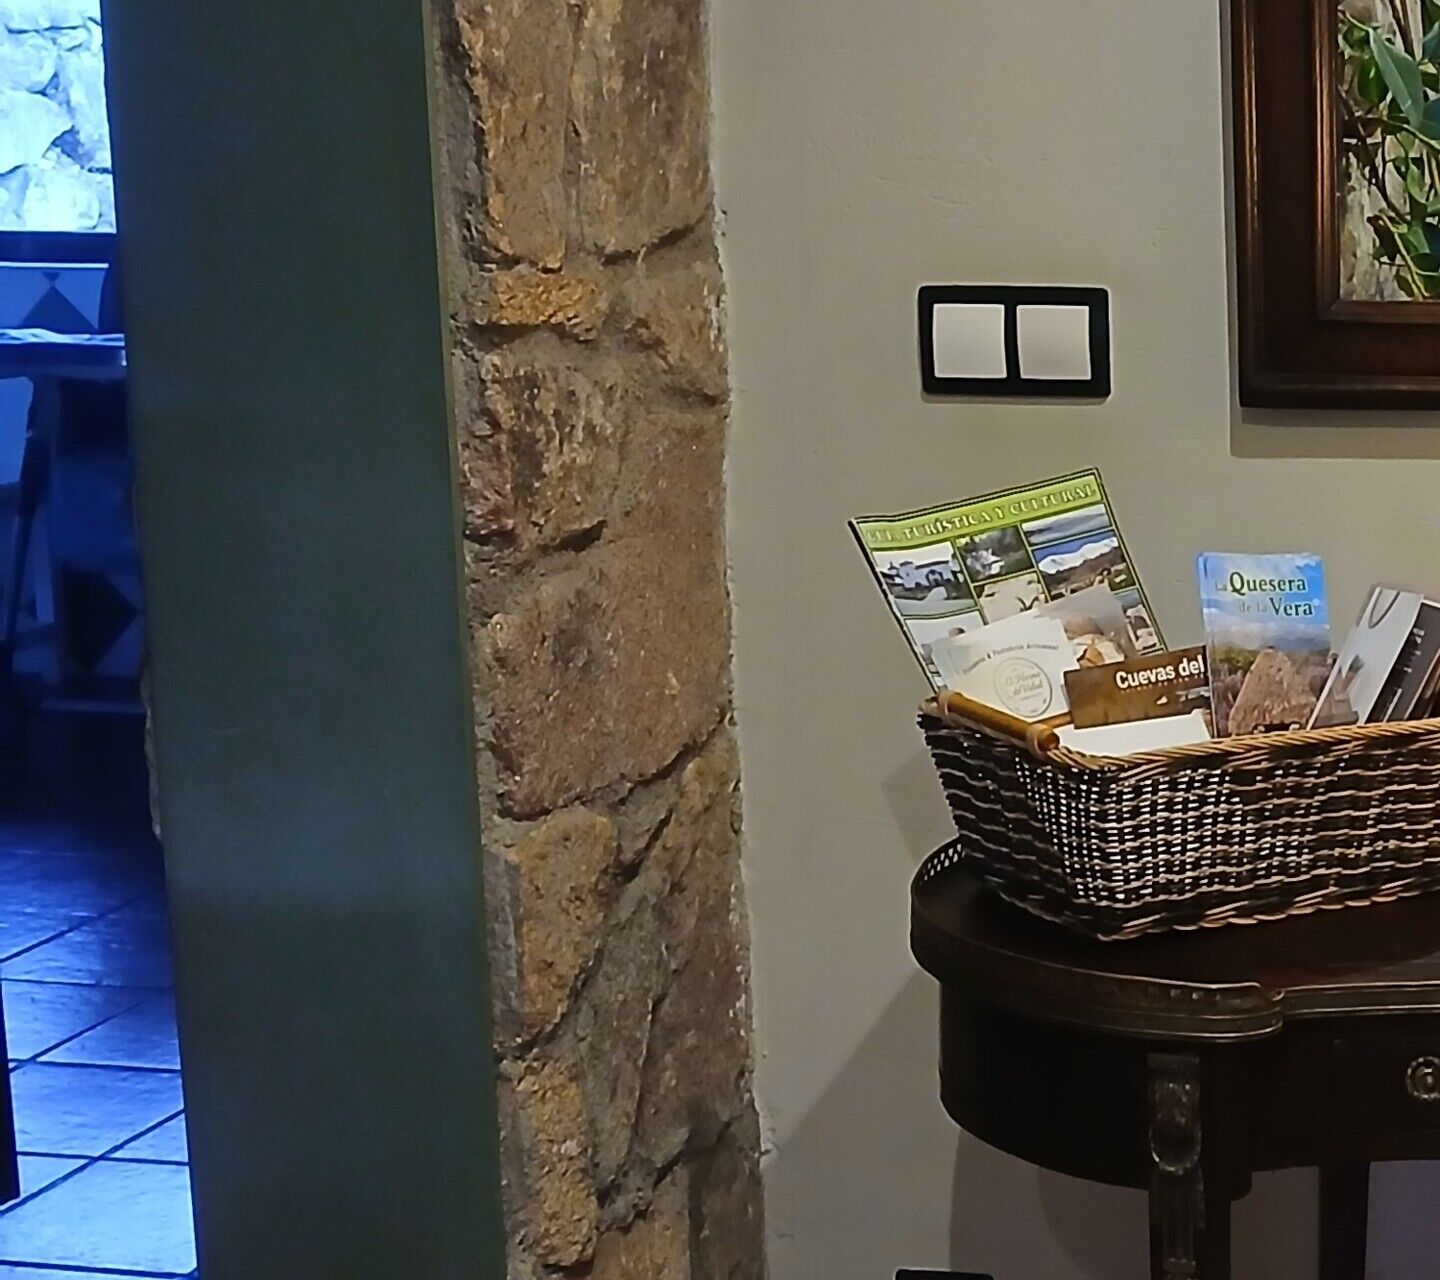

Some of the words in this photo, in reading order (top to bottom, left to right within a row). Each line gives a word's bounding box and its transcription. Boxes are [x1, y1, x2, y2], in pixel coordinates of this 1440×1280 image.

[994, 503, 1006, 520] Y
[1009, 484, 1099, 517] CULTURAL
[1229, 571, 1307, 597] Quesera
[1239, 601, 1251, 613] de
[1257, 601, 1268, 613] la
[1269, 596, 1314, 617] Vera
[1115, 661, 1177, 690] Cuevas
[1179, 654, 1206, 677] del
